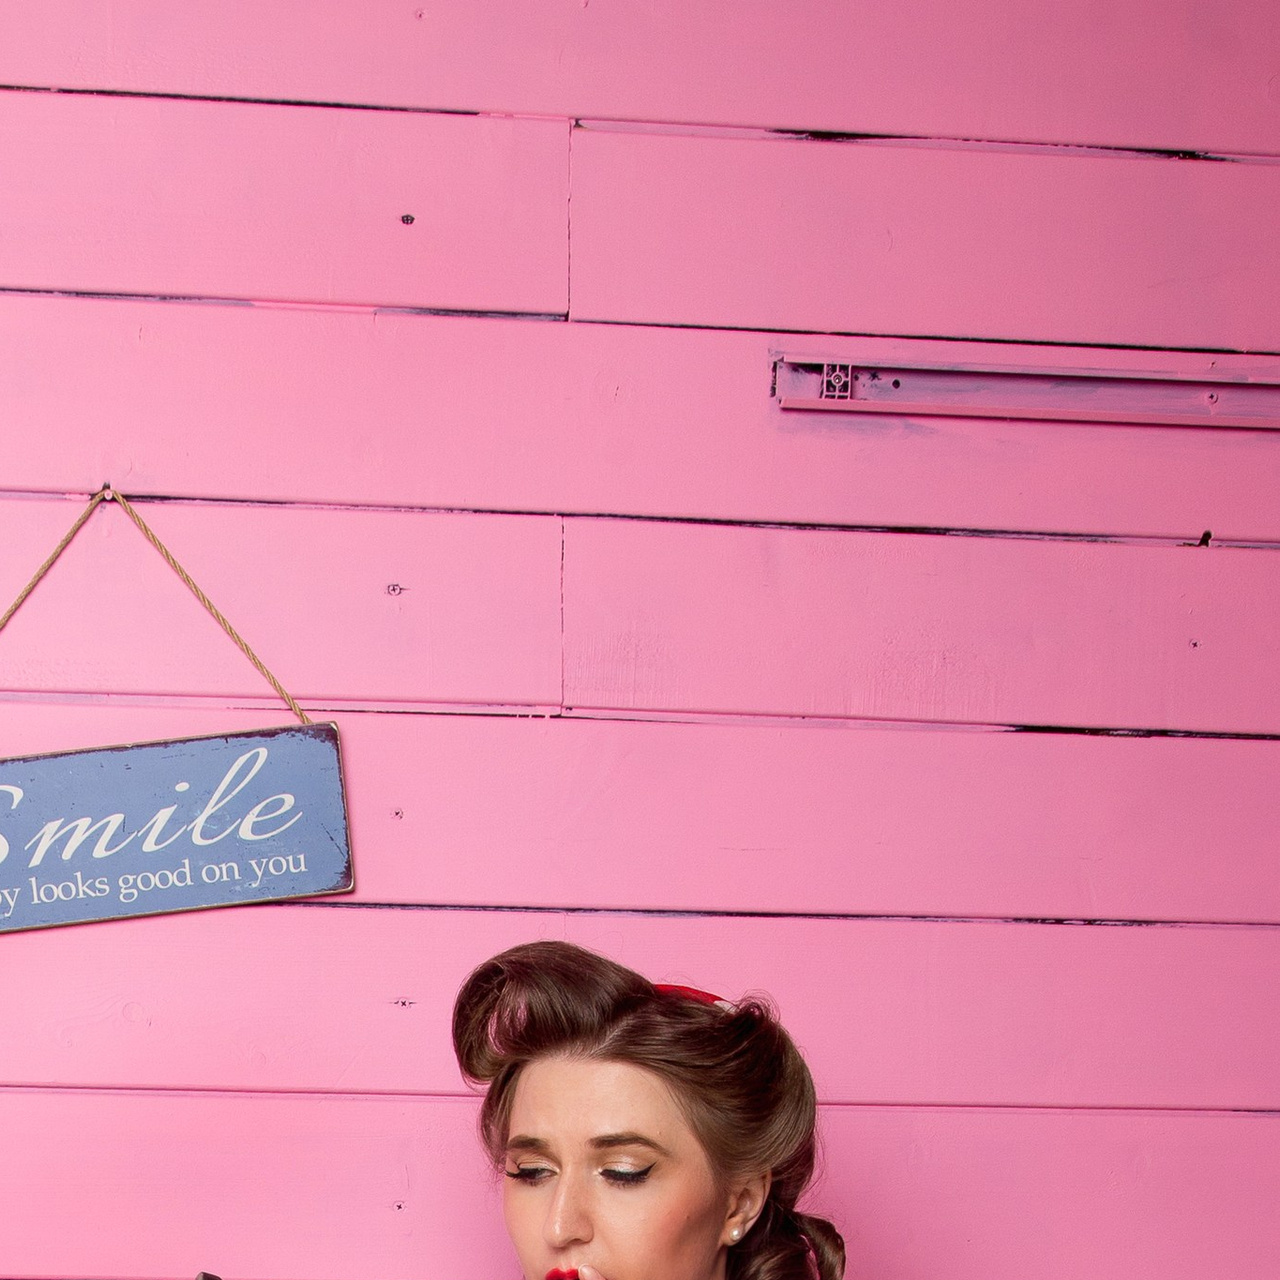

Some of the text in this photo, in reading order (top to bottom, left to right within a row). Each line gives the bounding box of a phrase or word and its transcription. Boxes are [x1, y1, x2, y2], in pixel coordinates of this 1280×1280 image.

[29, 872, 110, 905] looks
[118, 860, 193, 902] good
[202, 860, 239, 884] on
[249, 852, 307, 887] you
